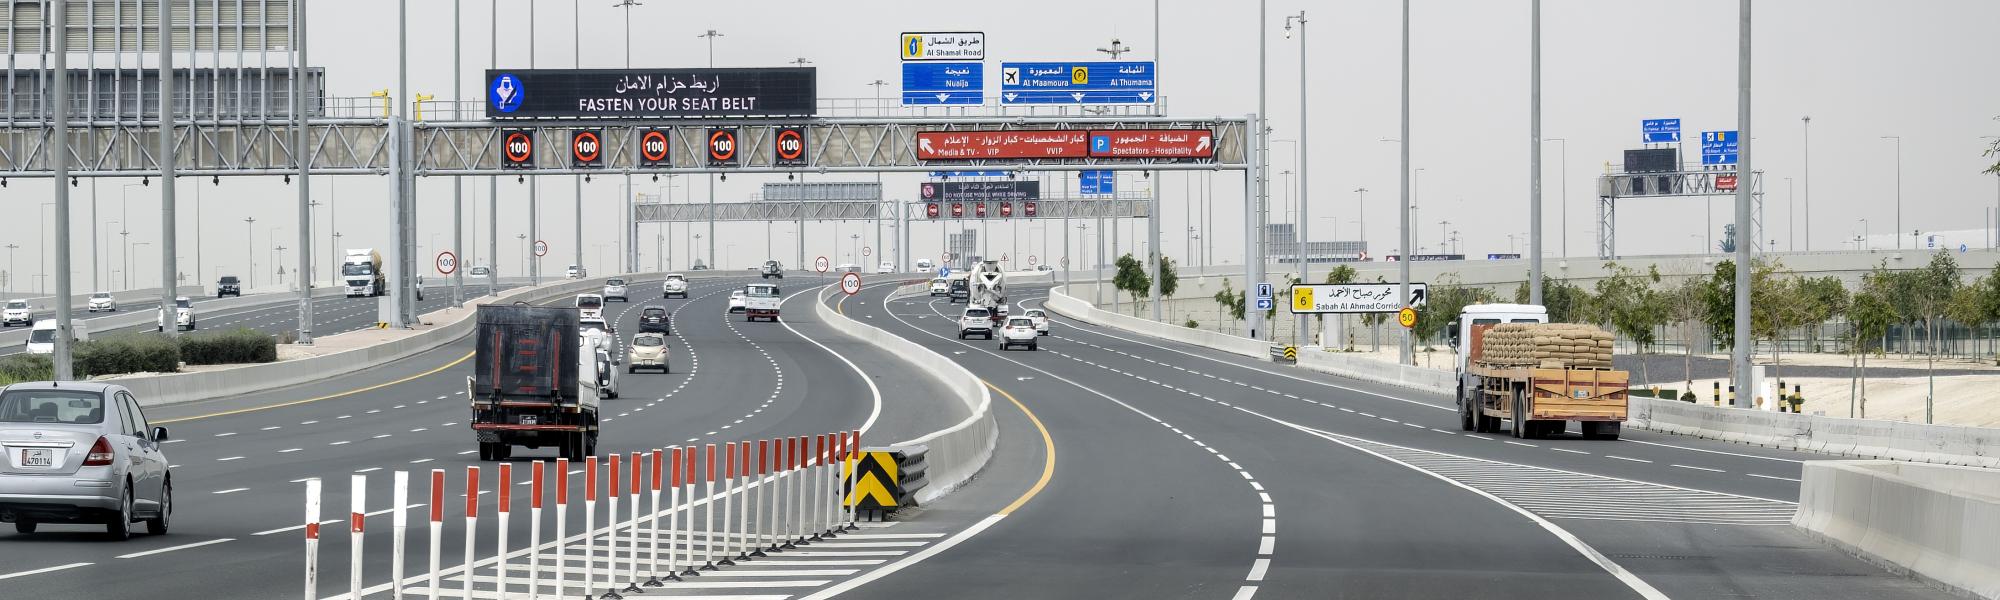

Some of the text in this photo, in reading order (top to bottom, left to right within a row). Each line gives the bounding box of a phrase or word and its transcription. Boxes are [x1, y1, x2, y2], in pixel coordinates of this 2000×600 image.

[928, 36, 980, 46] طريق الشمال
[945, 66, 970, 76] نعيجة
[1030, 66, 1063, 75] المعمورة
[1118, 66, 1145, 74] الثمامة
[616, 75, 720, 95] اربط حزام الامان
[945, 80, 969, 88] Nuaija
[579, 96, 756, 112] FASTEN YOUR SEAT BELT
[944, 136, 969, 147] الإعلام
[981, 136, 1001, 145] الزوار
[1003, 136, 1018, 145] كبار
[1070, 134, 1084, 144] كبار
[1115, 134, 1147, 144] الجمهور
[1159, 134, 1188, 143] الضيافة
[510, 142, 528, 153] 100
[578, 142, 596, 152] 100
[646, 141, 664, 152] 100
[714, 140, 732, 151] 100
[781, 140, 799, 150] 100
[1098, 139, 1104, 149] P
[1352, 288, 1372, 299] صباح
[1373, 287, 1392, 300] محور
[1300, 297, 1306, 305] 6
